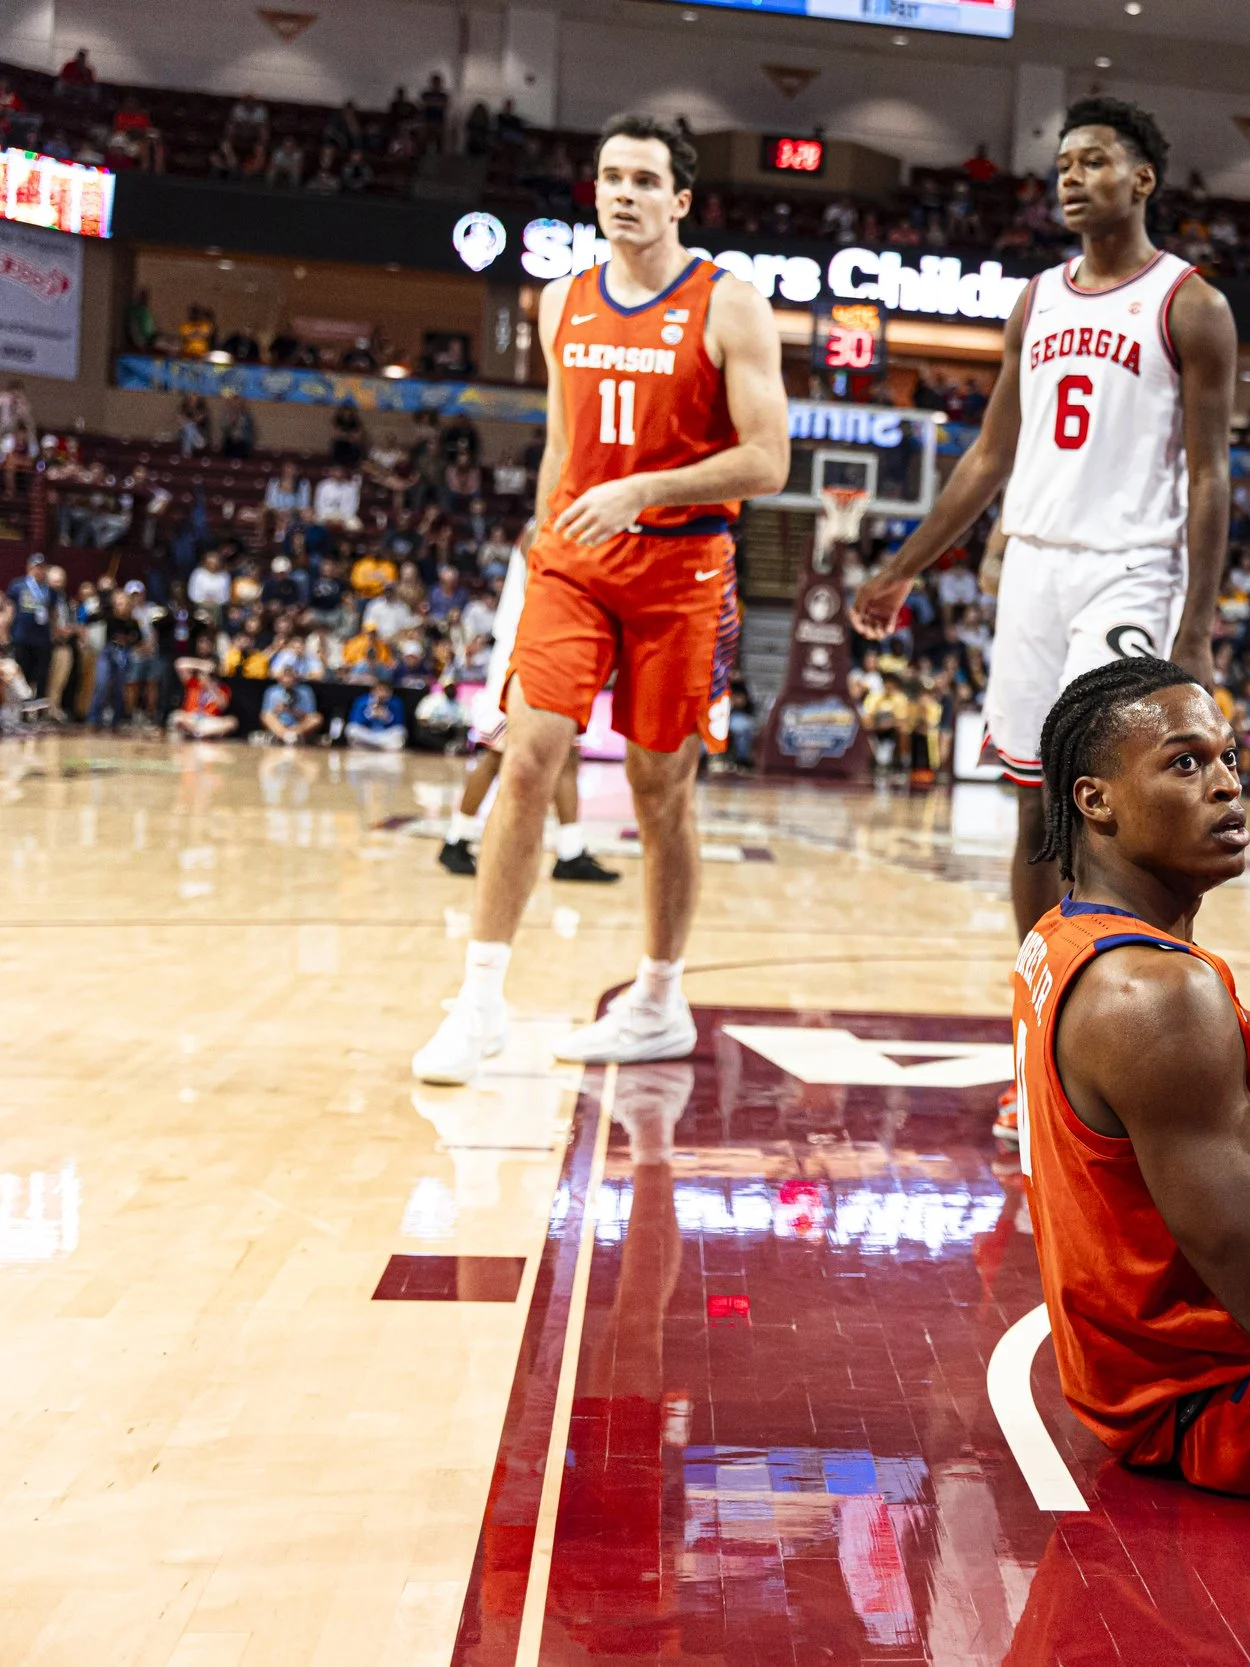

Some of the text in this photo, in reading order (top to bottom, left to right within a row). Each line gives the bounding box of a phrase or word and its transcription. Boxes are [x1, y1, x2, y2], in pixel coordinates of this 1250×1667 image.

[520, 217, 820, 302] Shers
[563, 342, 676, 375] CLEMSON
[825, 327, 874, 368] 30
[1030, 327, 1141, 378] GEORGIA
[598, 378, 636, 446] 11
[1054, 374, 1093, 450] 6
